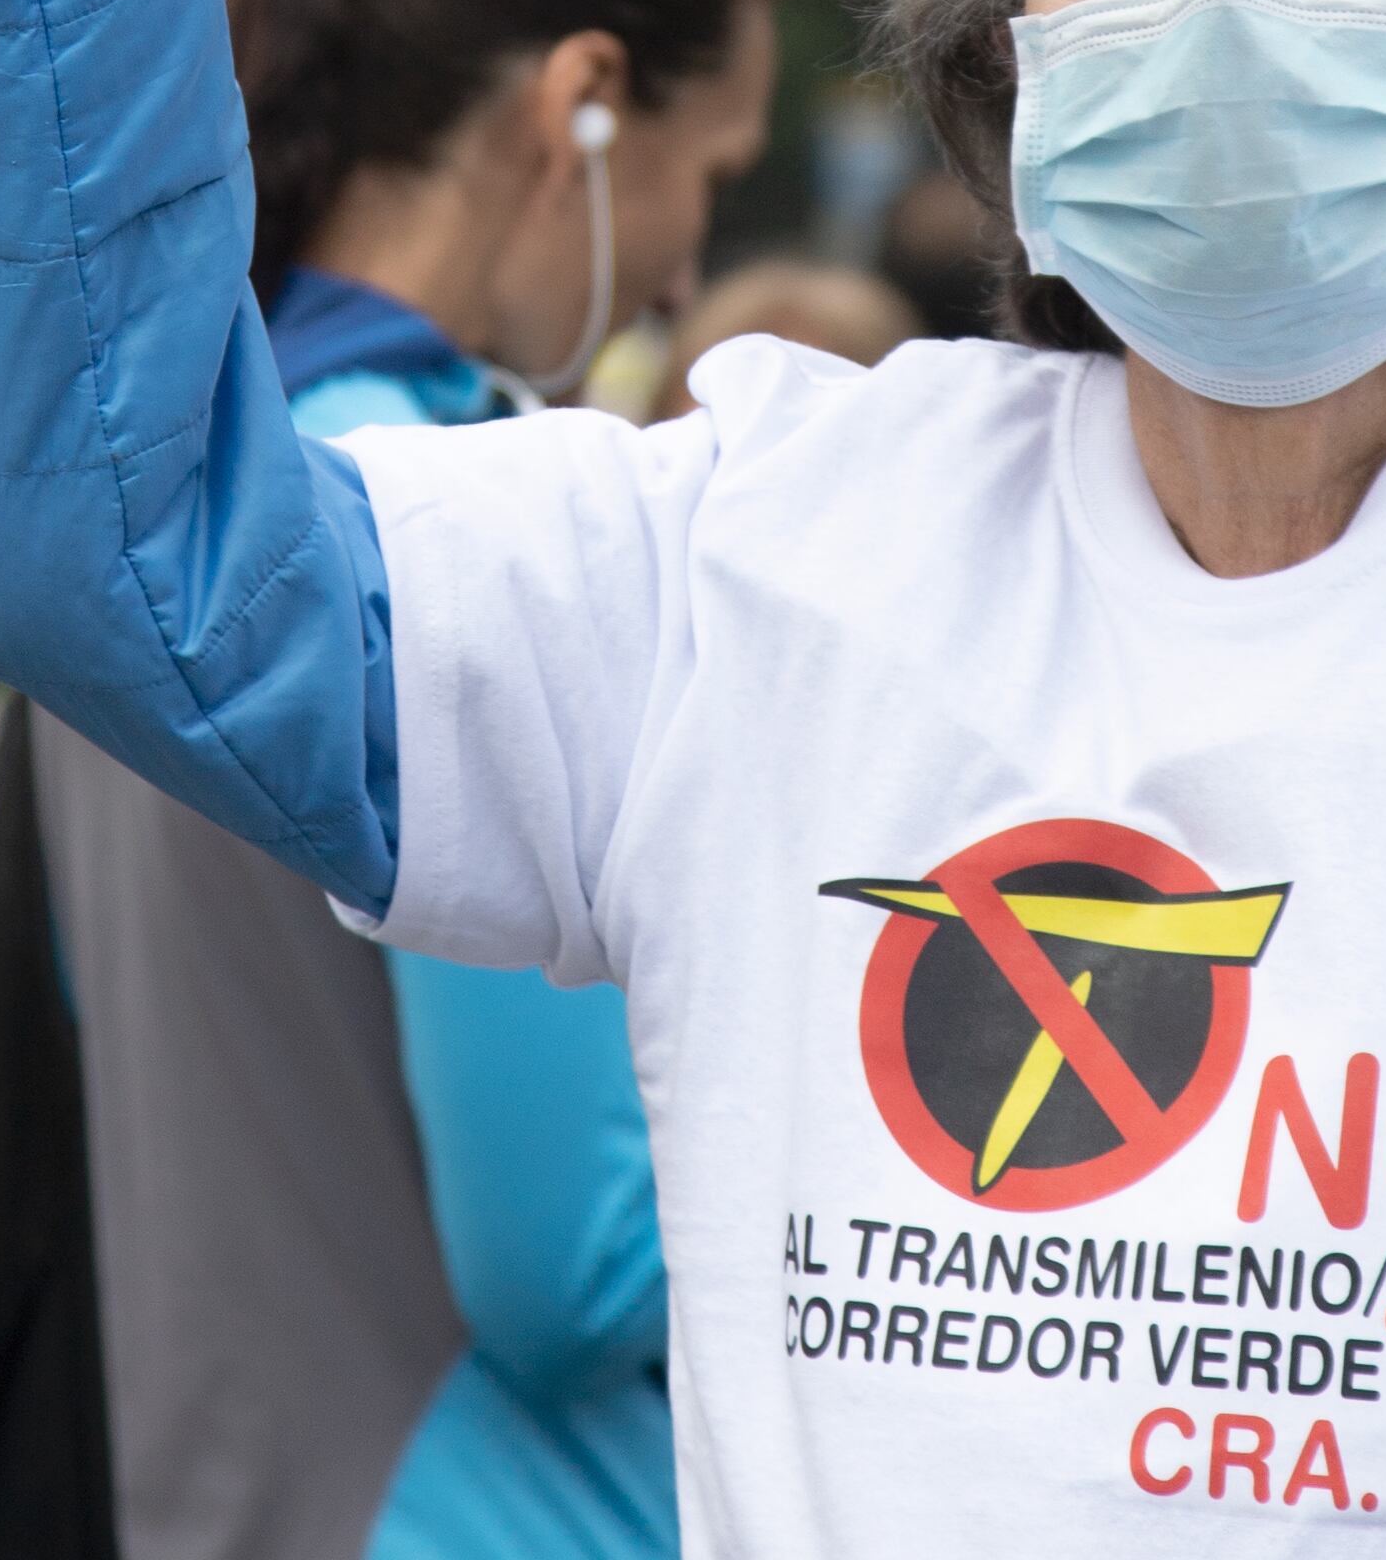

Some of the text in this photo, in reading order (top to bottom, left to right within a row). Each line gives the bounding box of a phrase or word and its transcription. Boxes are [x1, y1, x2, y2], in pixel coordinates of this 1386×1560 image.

[783, 1213, 828, 1276] AL
[784, 1296, 1385, 1402] CORREDOR VERDE
[1128, 1407, 1380, 1513] CRA.
